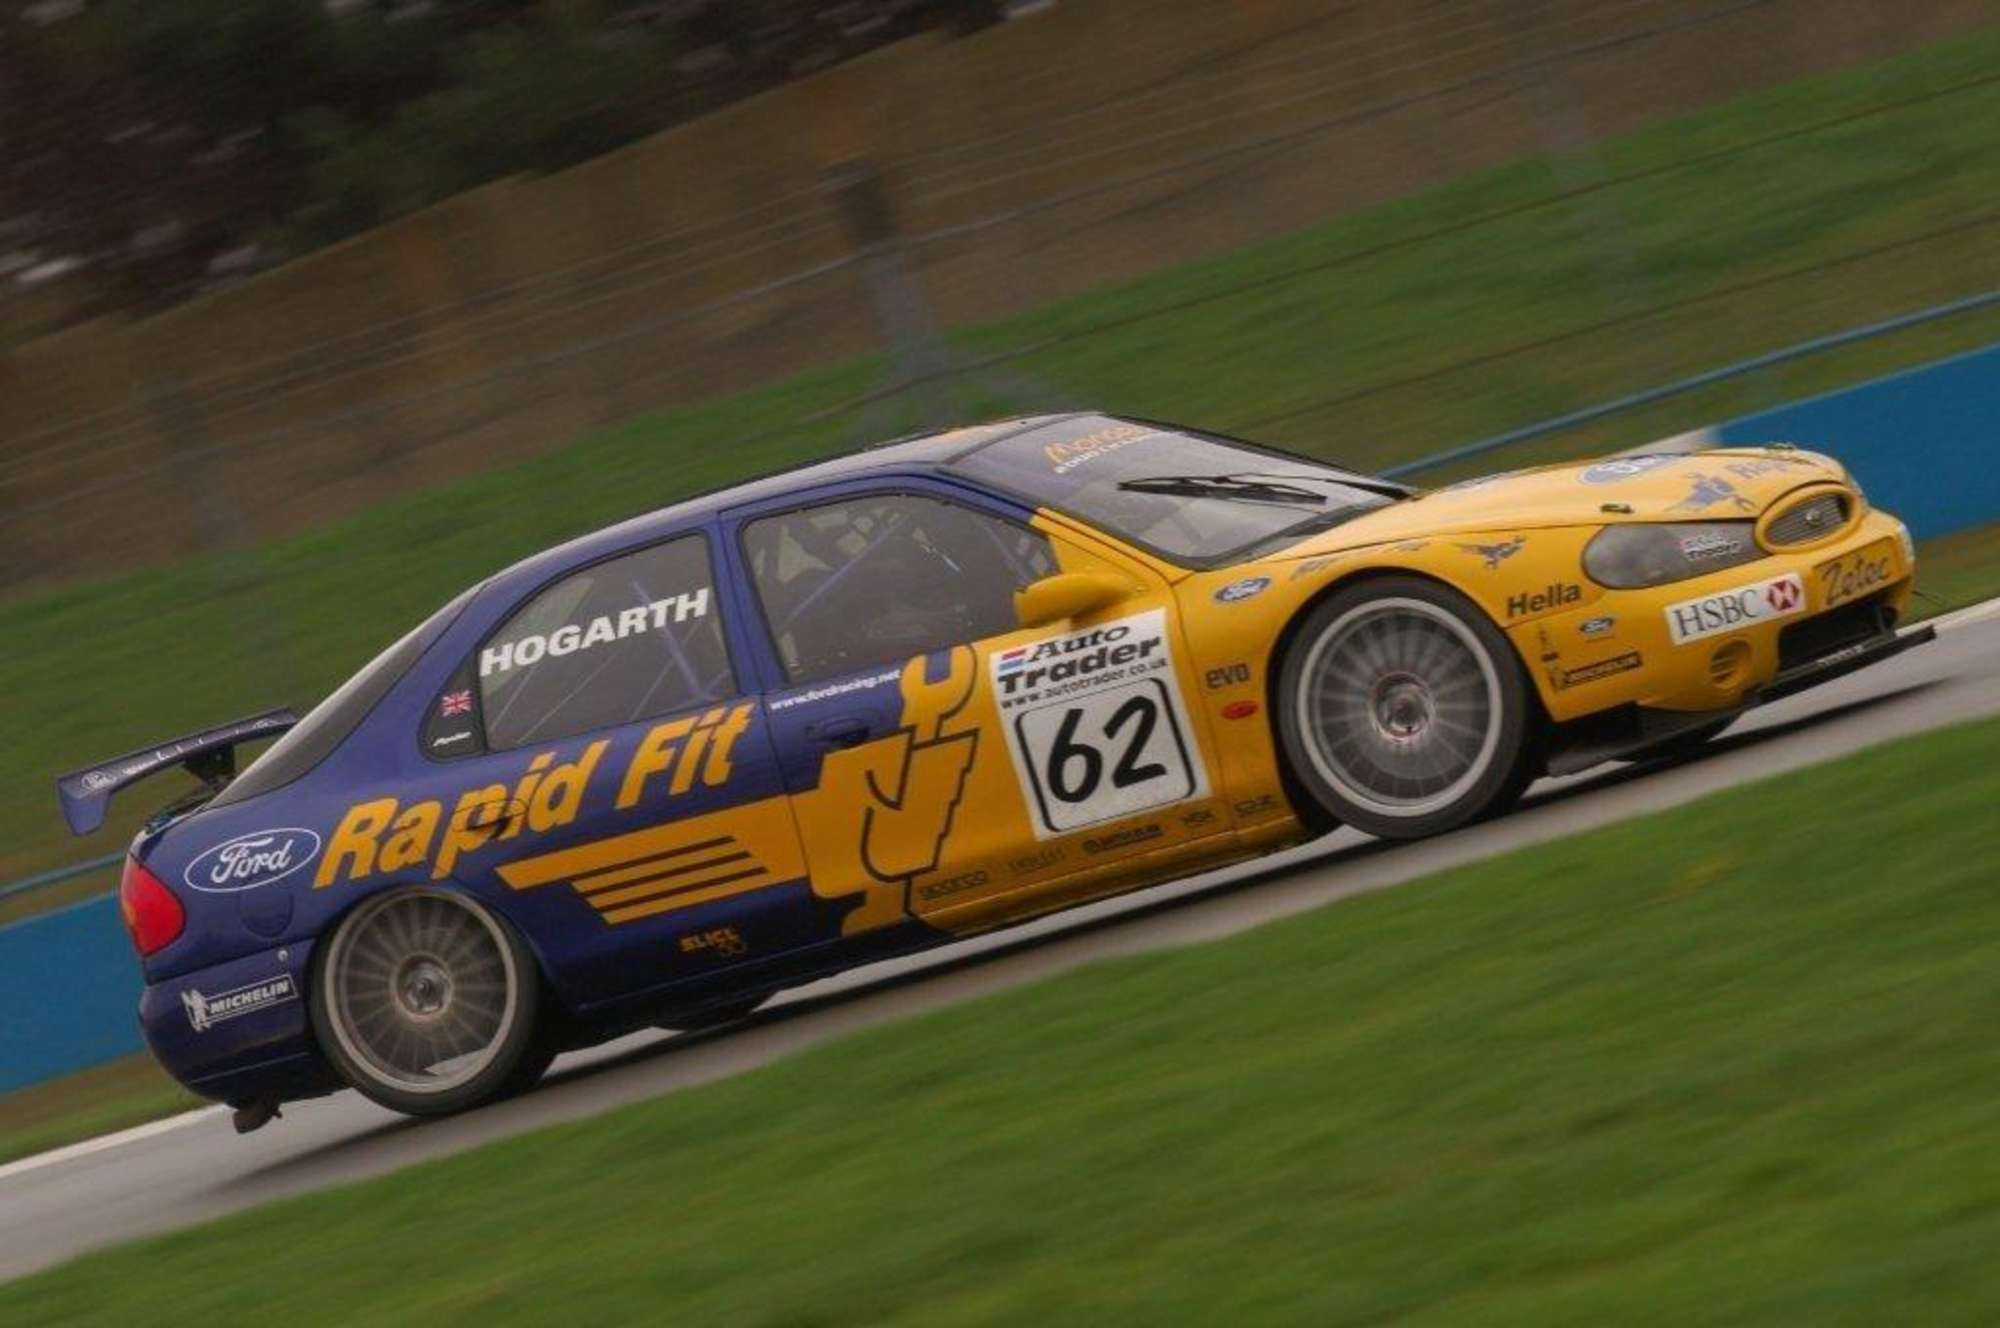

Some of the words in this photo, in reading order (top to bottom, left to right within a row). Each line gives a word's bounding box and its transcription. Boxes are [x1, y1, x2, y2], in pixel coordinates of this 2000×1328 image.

[1507, 582, 1581, 617] Hella
[1673, 589, 1760, 636] HSBC
[480, 588, 709, 677] HOGARTH
[1028, 626, 1130, 662] Auto
[998, 636, 1160, 693] Trader
[1001, 658, 1168, 709] www.autotrader.co.uk
[1206, 664, 1249, 690] evo
[1047, 695, 1167, 803] 62
[313, 740, 610, 889] Rapid
[614, 702, 756, 809] Fit
[211, 837, 293, 883] Ford
[210, 981, 290, 1014] MICHELIN
